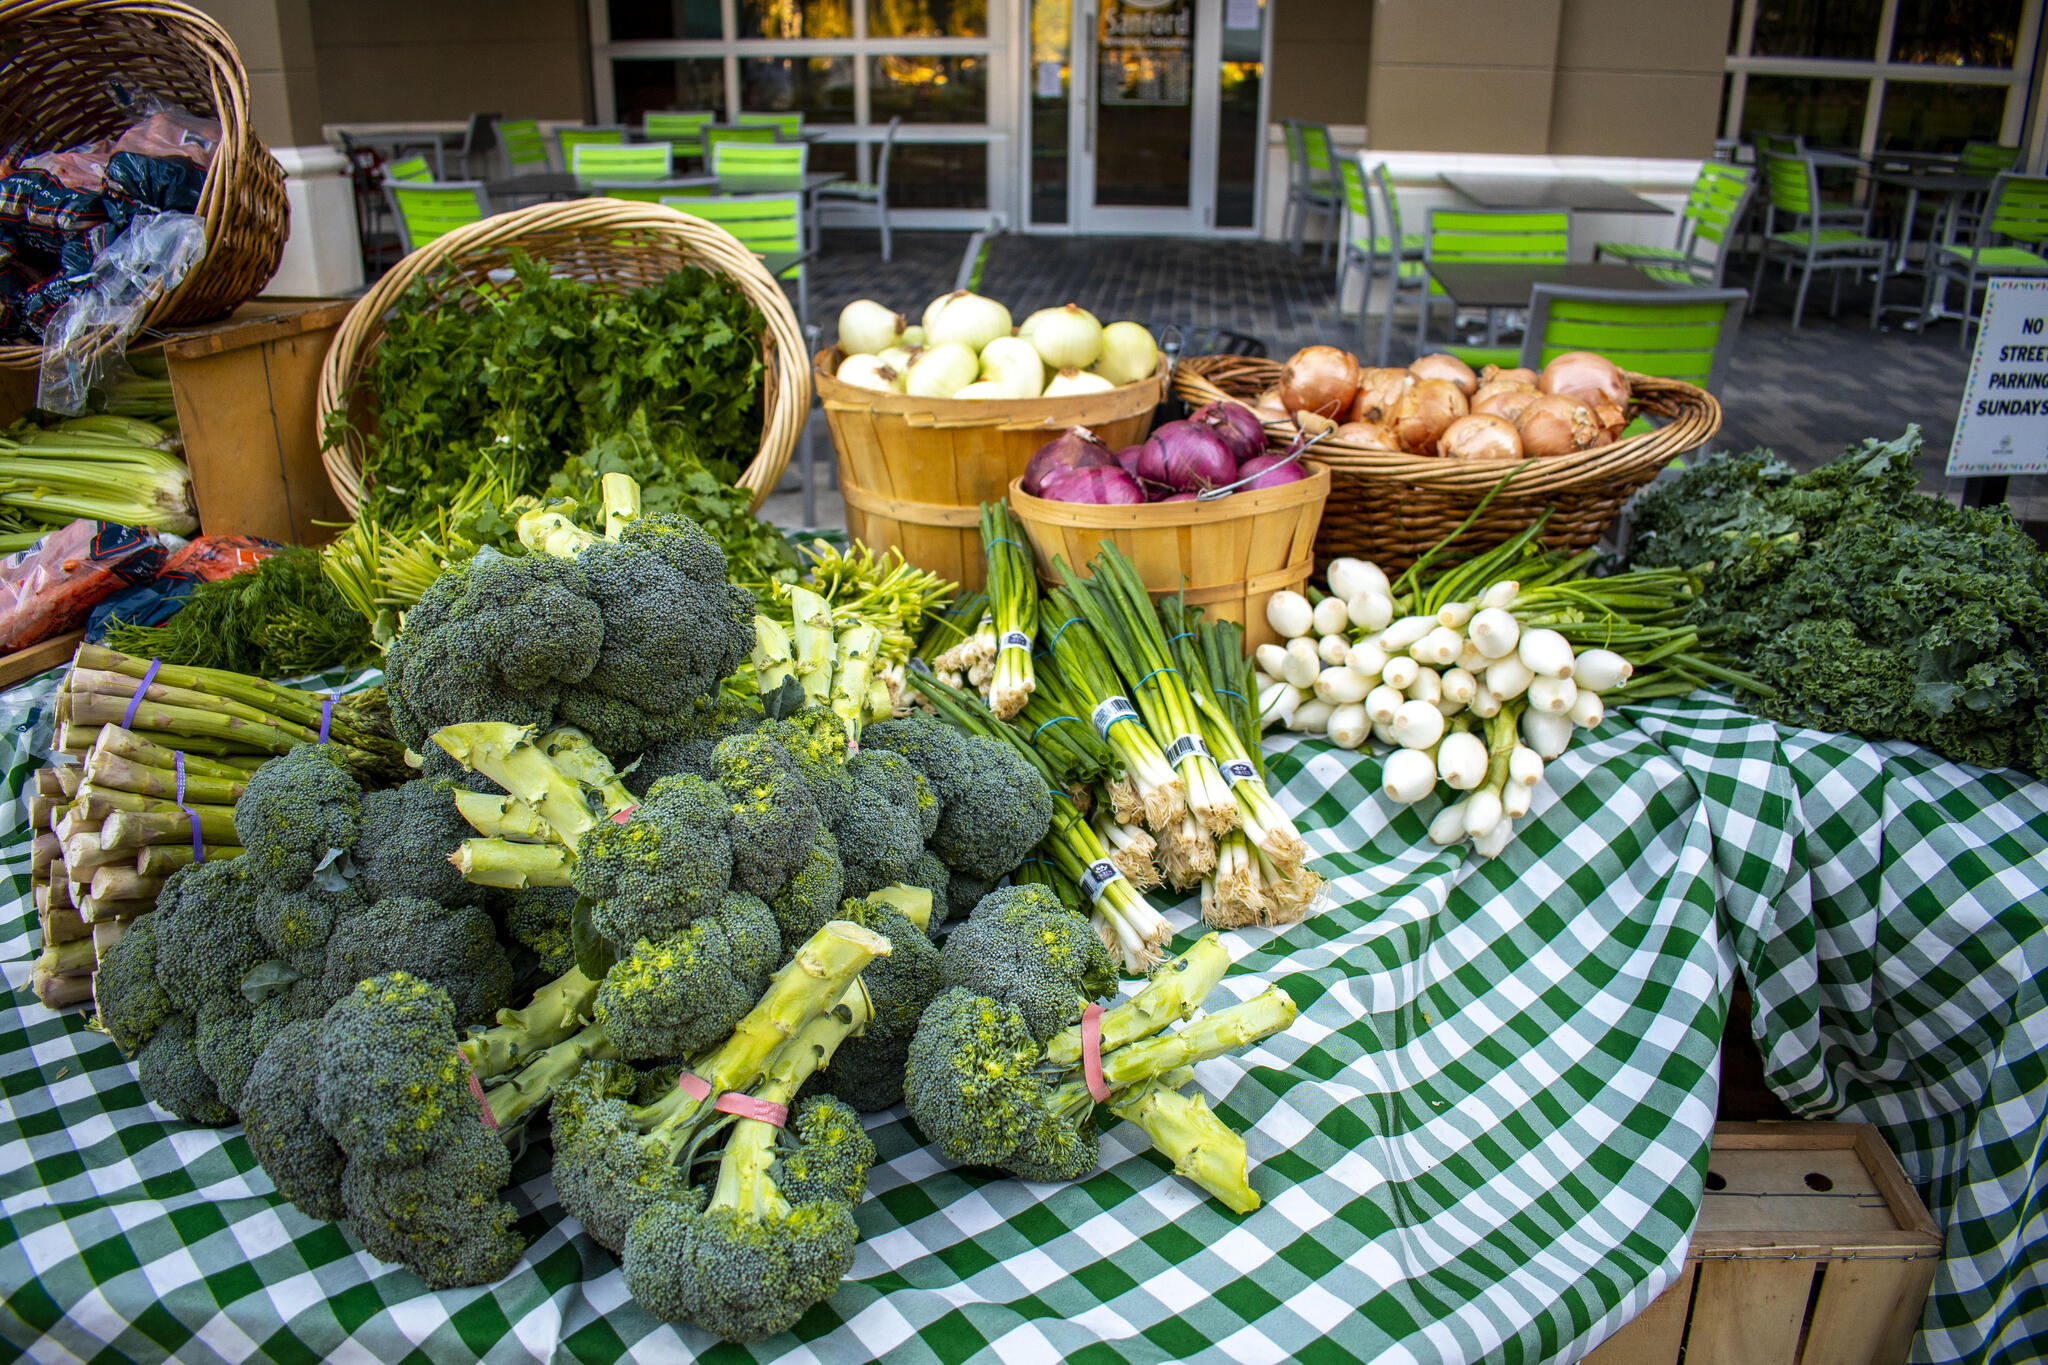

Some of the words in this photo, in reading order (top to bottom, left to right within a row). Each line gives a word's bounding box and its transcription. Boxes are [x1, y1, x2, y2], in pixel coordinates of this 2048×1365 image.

[1104, 8, 1190, 35] Sanford
[2022, 317, 2044, 335] NO
[1988, 372, 2048, 389] PARKING
[1976, 400, 2048, 416] SUNDAYS
